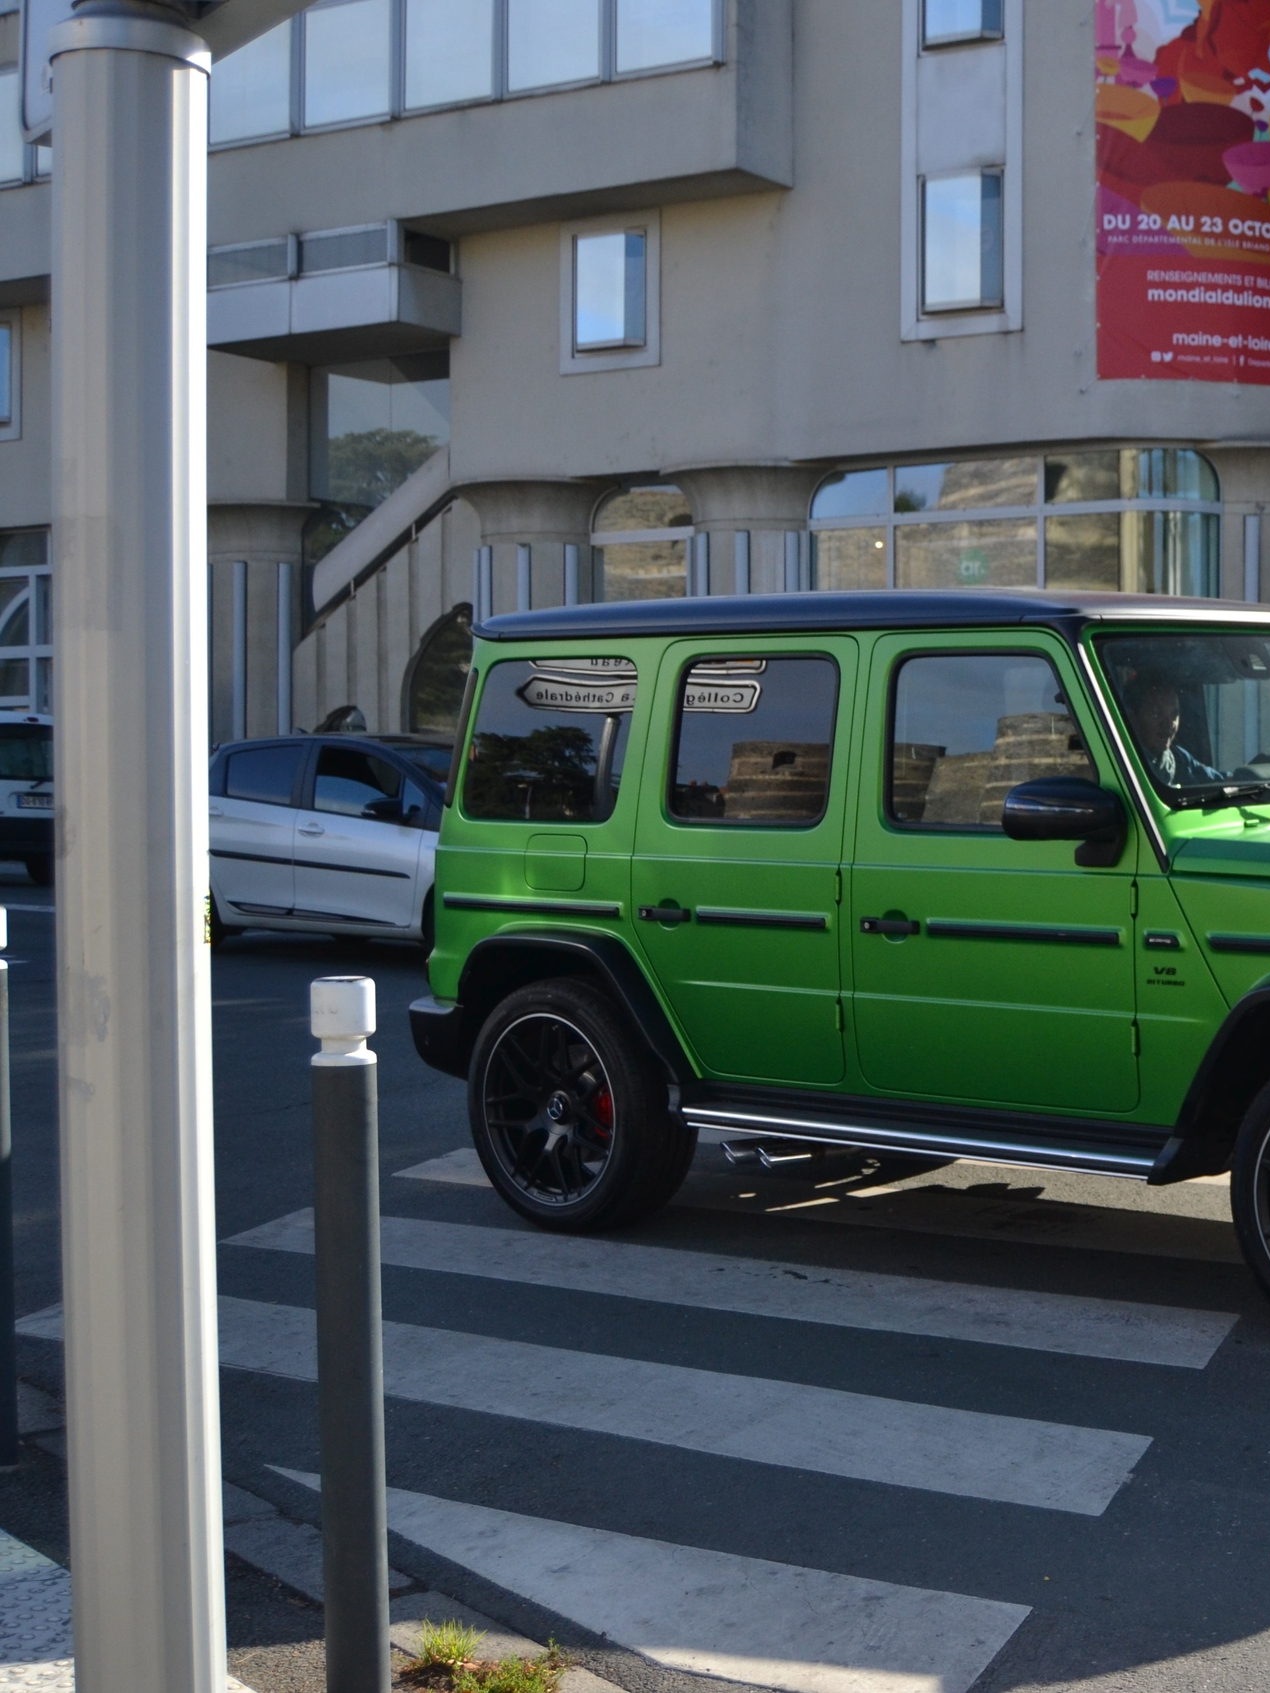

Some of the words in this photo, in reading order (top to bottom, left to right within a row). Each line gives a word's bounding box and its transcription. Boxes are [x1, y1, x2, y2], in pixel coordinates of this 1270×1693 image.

[1103, 214, 1131, 231] DU
[1137, 214, 1161, 231] 20
[1167, 214, 1195, 231] AU
[1200, 216, 1223, 233] 23
[1107, 234, 1130, 244] PARC
[1132, 233, 1202, 246] DÉPARTEMENTAL
[1204, 237, 1215, 246] DE
[1146, 270, 1242, 286] RENSEIGNEMENTS
[1244, 275, 1255, 287] ET
[1153, 966, 1177, 976] V8
[1146, 979, 1185, 987] BITURBO
